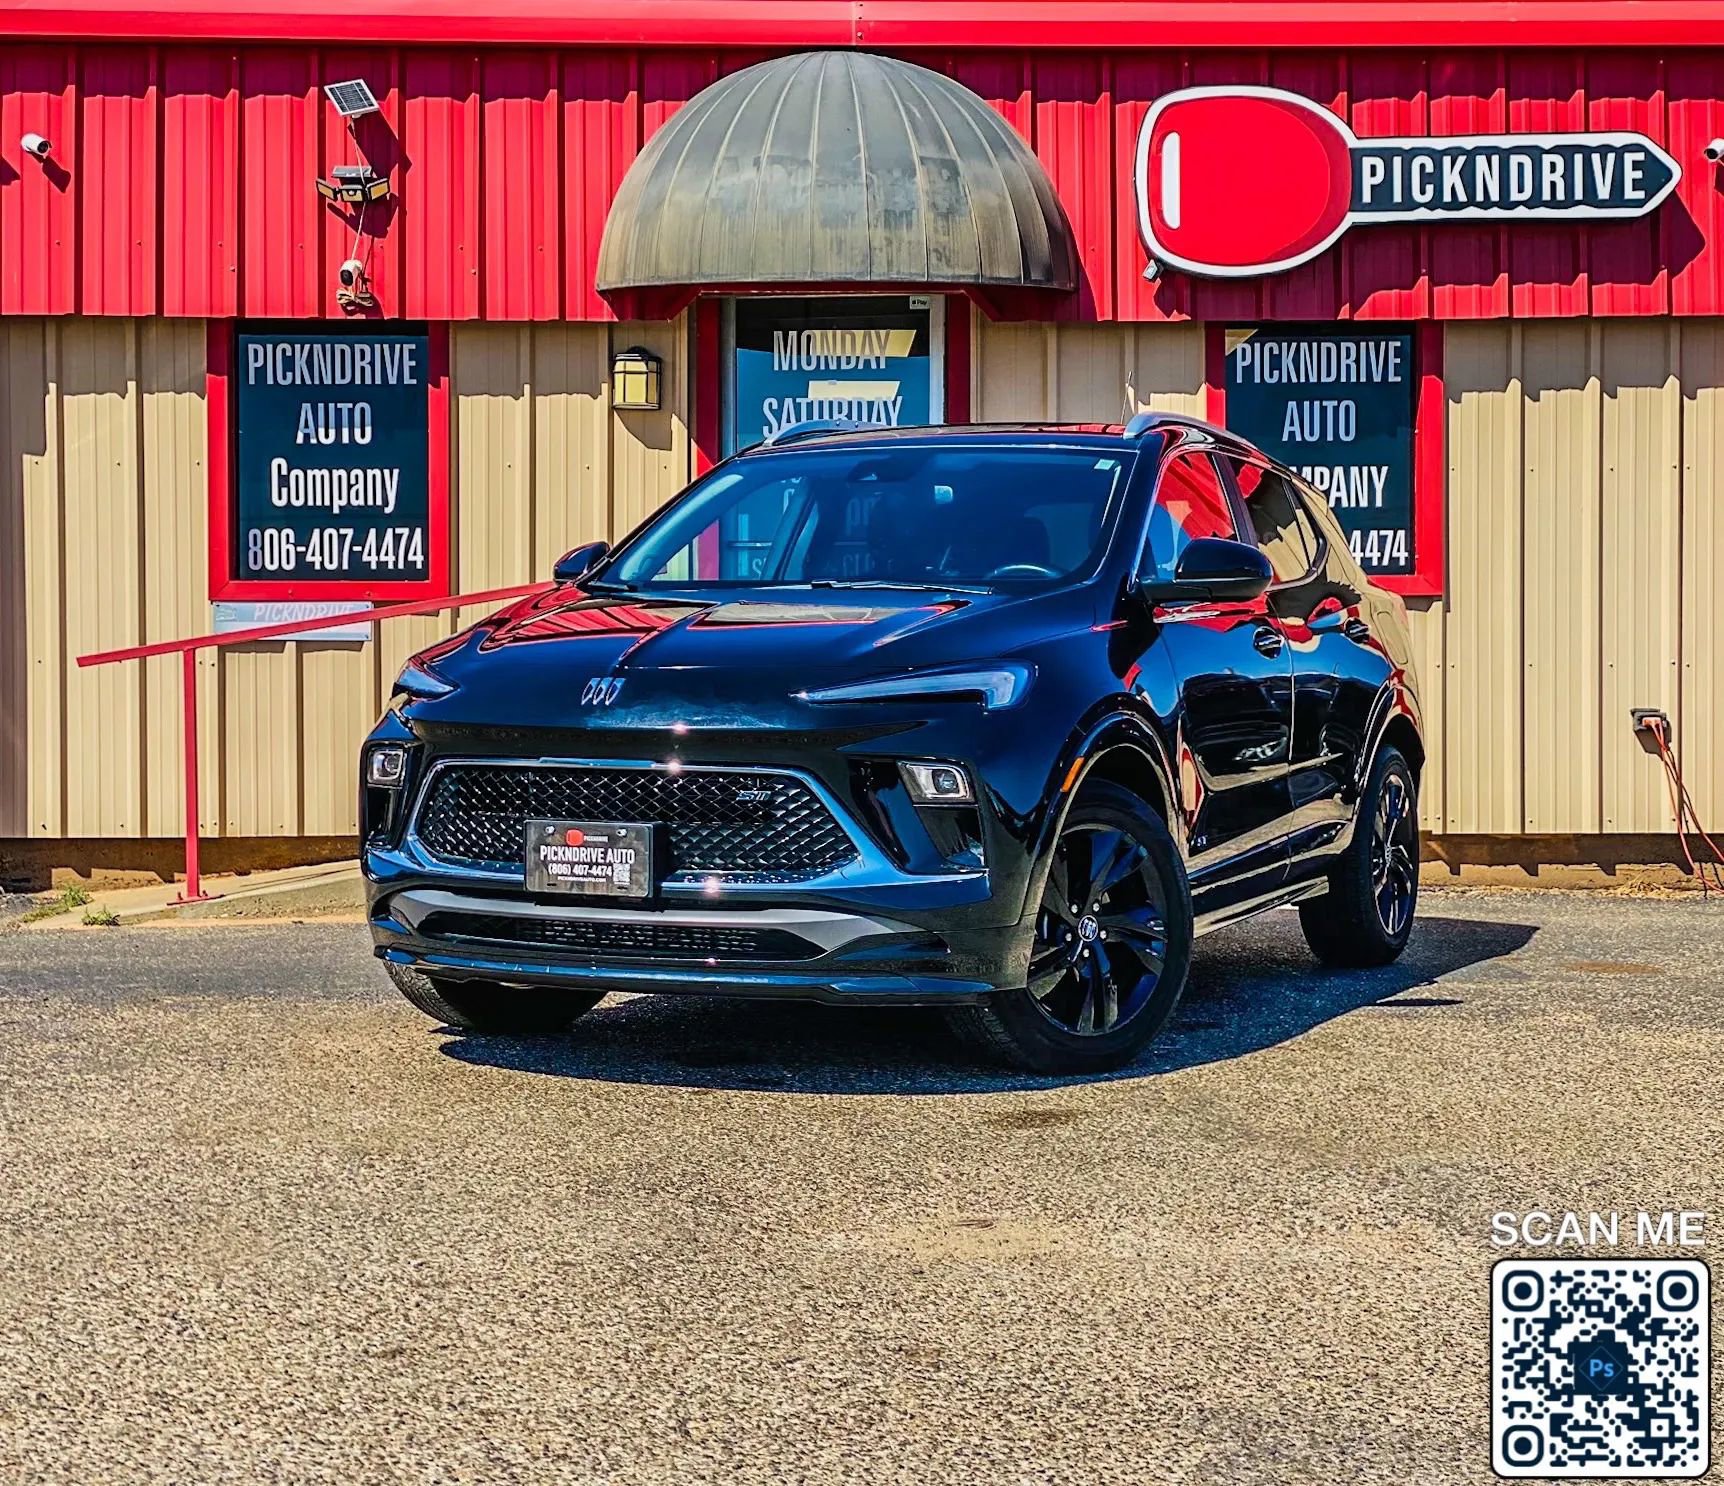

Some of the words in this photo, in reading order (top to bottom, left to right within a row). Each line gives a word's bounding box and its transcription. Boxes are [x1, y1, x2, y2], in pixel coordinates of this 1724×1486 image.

[1361, 151, 1646, 204] PICKNDRIVE
[247, 343, 417, 386] PICKNDRIVE
[773, 329, 891, 371] MONDAY
[1236, 341, 1402, 384] PICKNDRIVE
[295, 402, 373, 445] AUTO
[1281, 400, 1356, 442] AUTO
[270, 457, 400, 515] Company
[1288, 465, 1389, 509] PANY
[247, 527, 425, 571] 806-407-4474
[540, 845, 605, 863] PICKNDRIVE
[606, 848, 636, 864] AUTO
[548, 863, 572, 875] (806)
[572, 864, 613, 877] 407-4474
